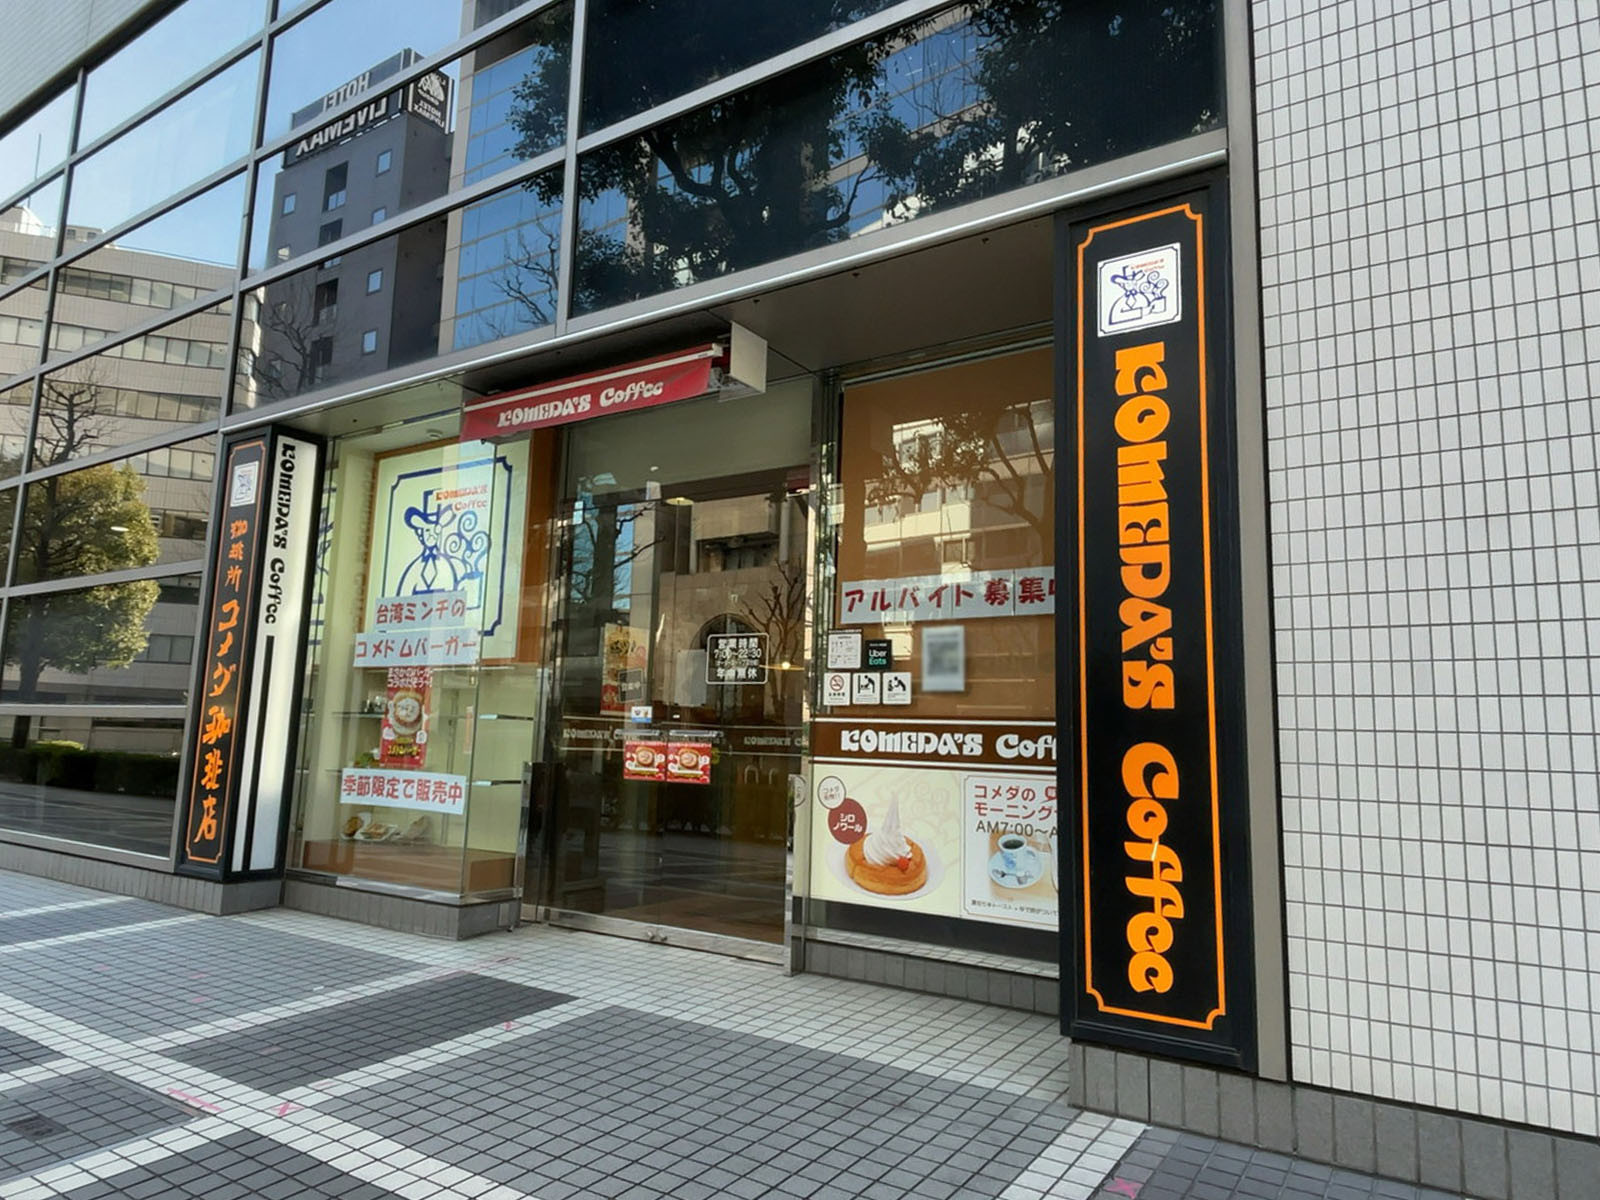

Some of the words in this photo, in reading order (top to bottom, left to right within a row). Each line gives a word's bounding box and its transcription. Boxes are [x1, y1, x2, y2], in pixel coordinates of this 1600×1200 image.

[497, 394, 592, 428] KOMEDA'S
[599, 380, 664, 408] Coffee
[272, 442, 297, 550] KOMEDA'S
[1114, 341, 1175, 709] KOMEDA'S
[265, 557, 286, 625] Coffee
[845, 577, 1056, 613] アルバイト募集
[376, 599, 465, 624] 台湾ミンチの
[356, 636, 476, 659] コメドムバーガー
[868, 649, 887, 658] Uber
[868, 656, 887, 665] Eats
[840, 729, 983, 756] KOMEDA'S
[342, 775, 463, 805] 季節限定で販売中
[974, 785, 1036, 802] コメダの
[832, 822, 863, 833] ノワール
[839, 813, 856, 823] シロ
[1121, 741, 1185, 993] Coffee
